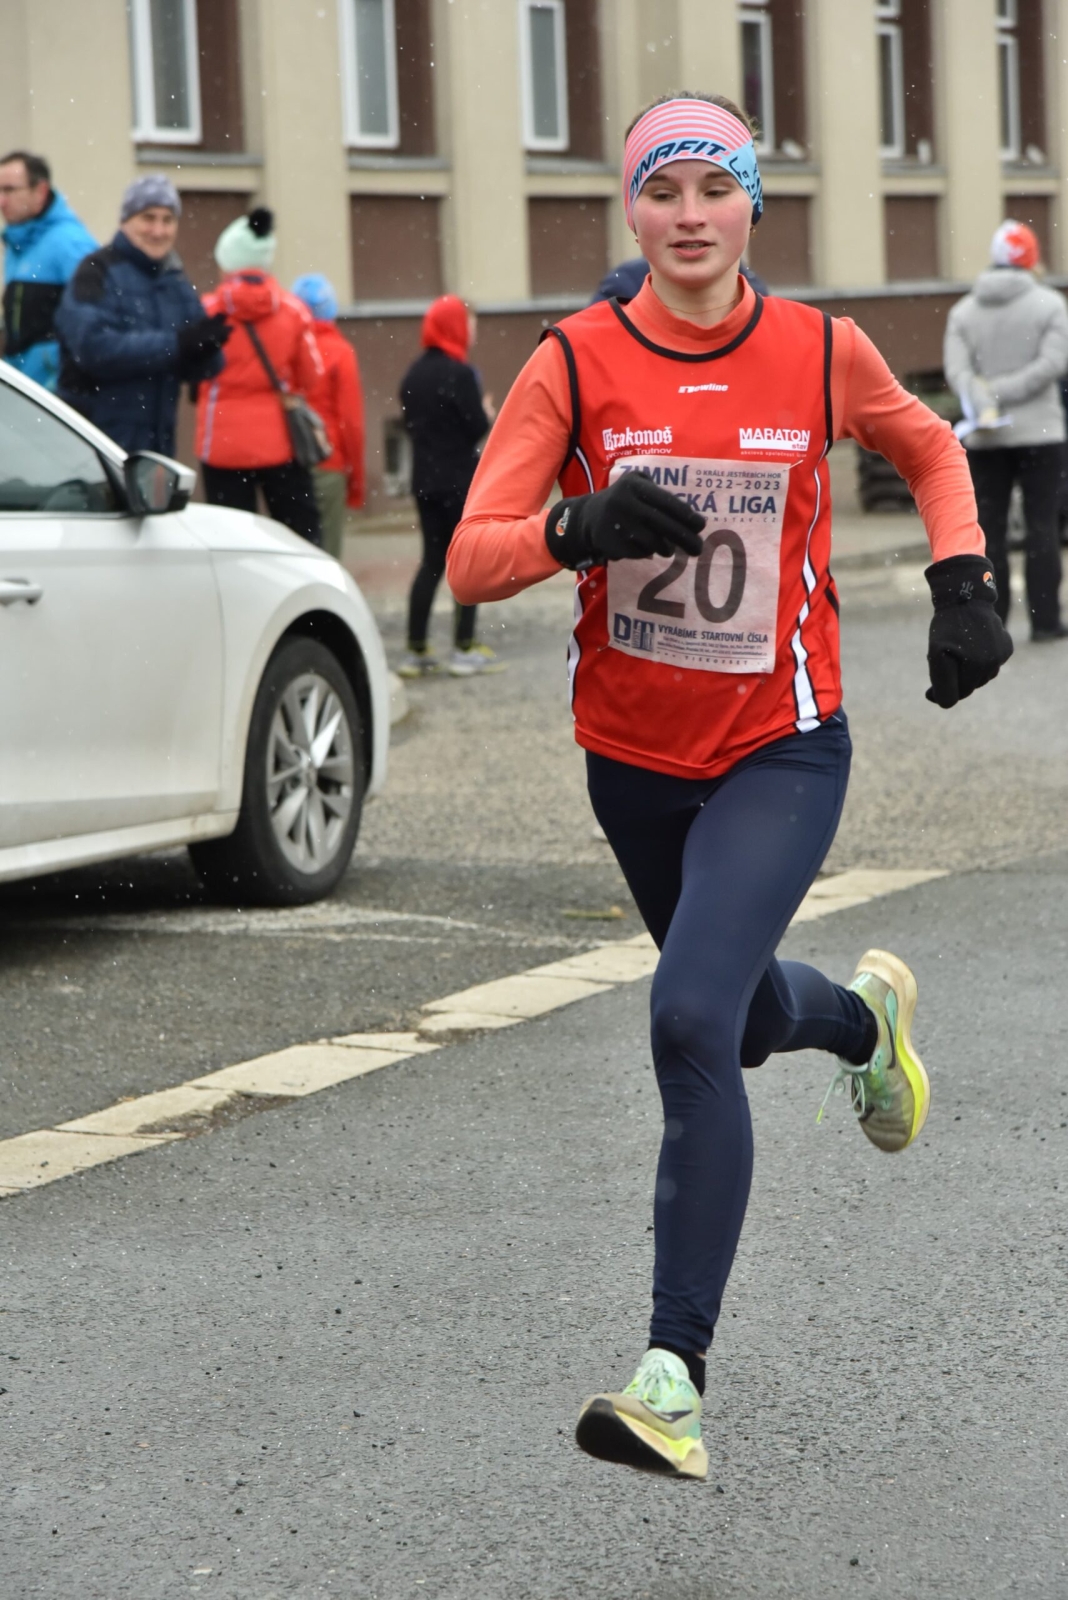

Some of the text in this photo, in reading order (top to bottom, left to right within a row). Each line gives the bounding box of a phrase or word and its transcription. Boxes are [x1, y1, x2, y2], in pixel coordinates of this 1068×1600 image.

[739, 427, 811, 442] MARATON
[635, 447, 672, 455] Trutnov
[703, 469, 725, 477] KRÁLE
[729, 496, 777, 514] LIGA
[637, 529, 747, 624] 20
[658, 624, 697, 639] VYRÁBÍME
[701, 630, 744, 643] STARTOVNÍ
[747, 633, 768, 643] ČÍSLA
